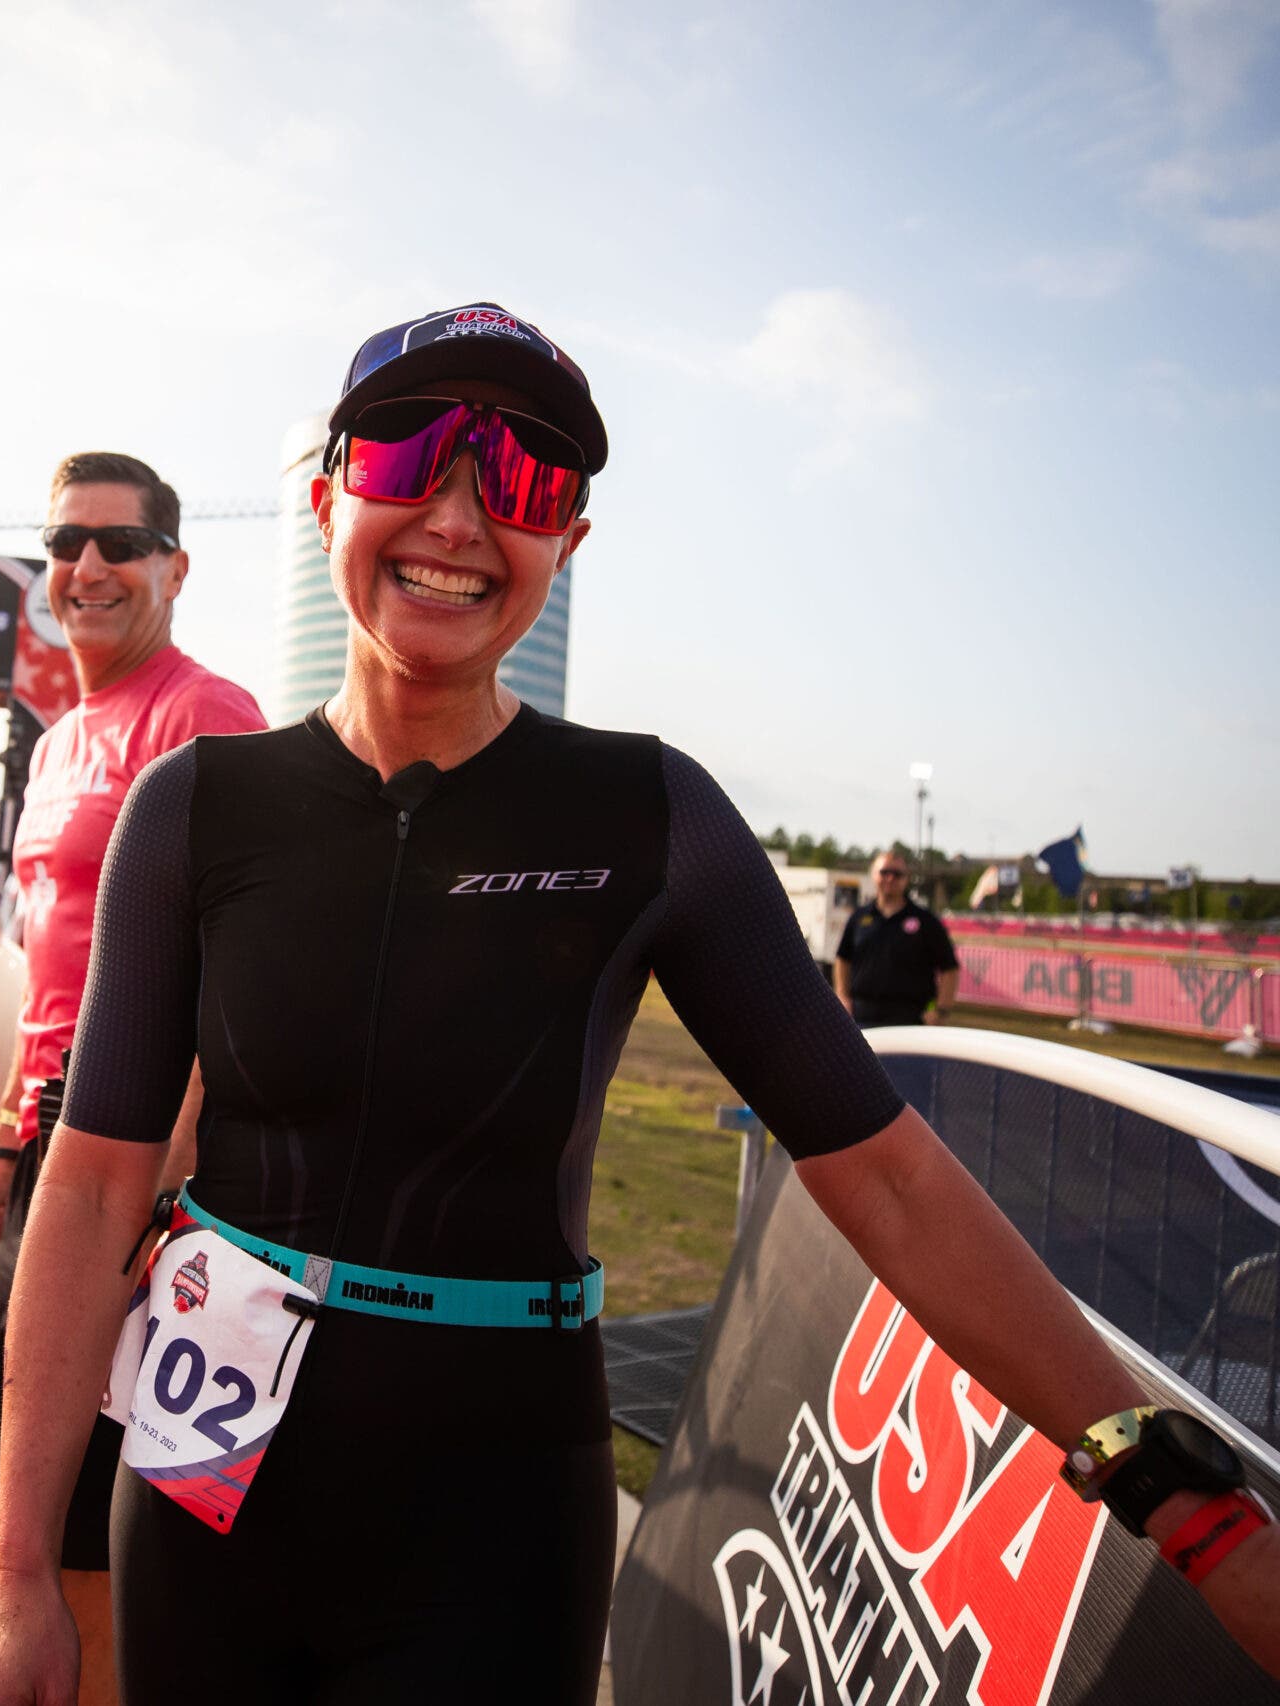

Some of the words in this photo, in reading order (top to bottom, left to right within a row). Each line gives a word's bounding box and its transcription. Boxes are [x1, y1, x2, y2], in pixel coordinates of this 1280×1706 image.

[454, 310, 517, 330] USA
[448, 869, 611, 894] ZONE3
[342, 1280, 434, 1311] IRONMAN
[160, 1435, 177, 1452] 2023
[828, 1277, 1110, 1706] USA
